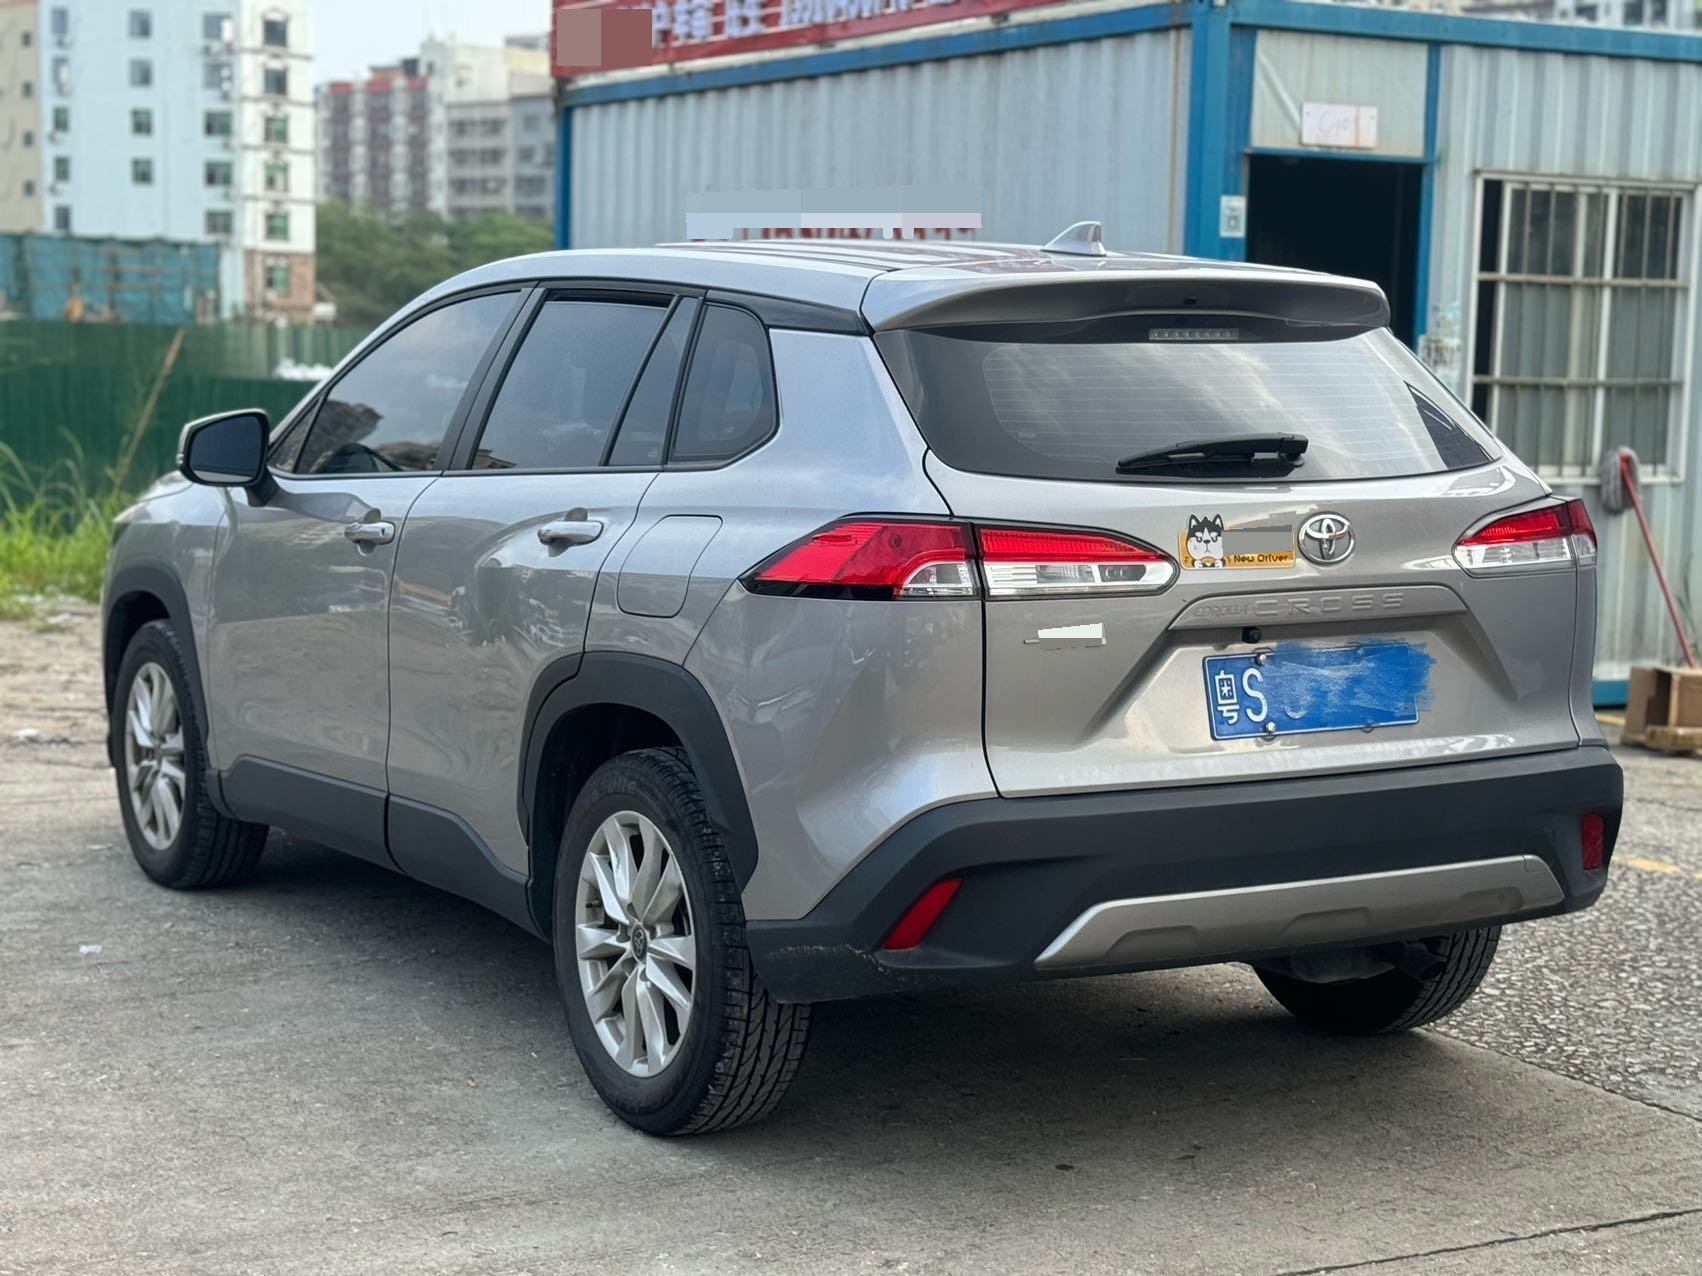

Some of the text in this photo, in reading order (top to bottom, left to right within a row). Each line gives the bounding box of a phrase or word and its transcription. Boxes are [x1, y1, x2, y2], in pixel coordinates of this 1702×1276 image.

[1233, 553, 1288, 563] New Driver
[1254, 592, 1404, 616] CROSS
